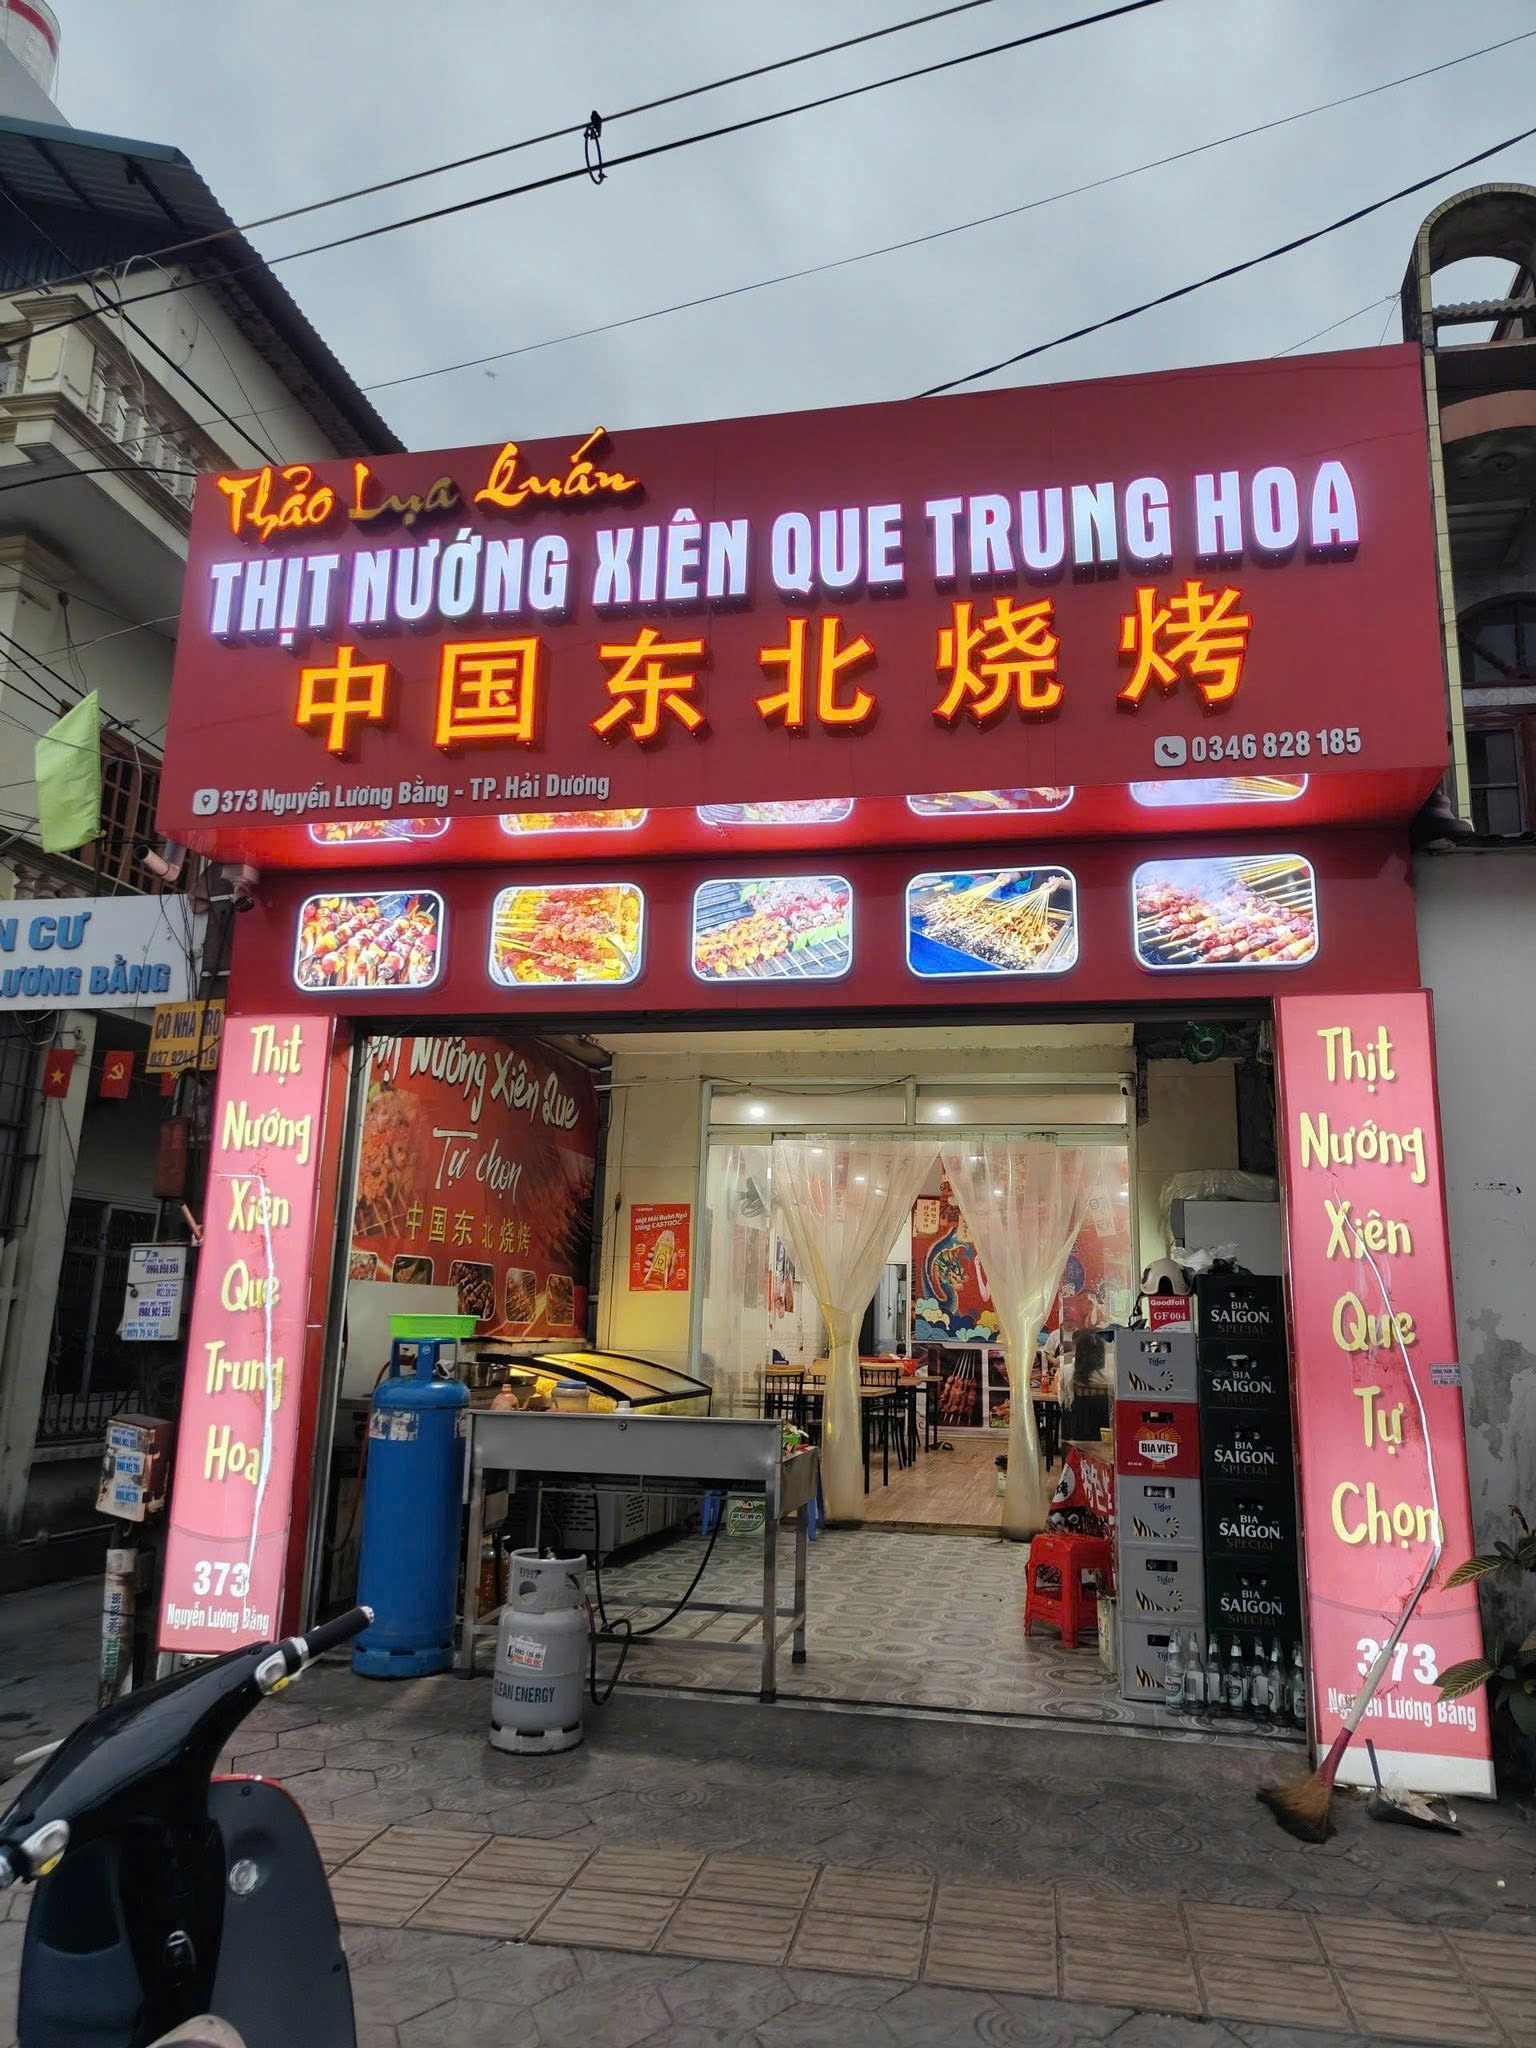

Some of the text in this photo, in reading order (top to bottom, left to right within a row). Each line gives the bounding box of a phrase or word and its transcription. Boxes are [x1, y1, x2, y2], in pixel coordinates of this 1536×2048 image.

[217, 426, 641, 543] Thảo Lụa Quán
[210, 460, 1360, 645] THỊT NƯỚNG XIÊN QUE TRUNG HOA
[295, 579, 1253, 754] 中国东北烧烤
[1191, 727, 1362, 762] 0346 828 185
[221, 789, 258, 813] 373
[261, 782, 331, 815] Nguyễn
[335, 783, 394, 810] Lương
[398, 776, 449, 808] Bằng
[470, 777, 502, 801] TP.
[504, 773, 542, 799] Hải
[546, 772, 610, 800] Dương
[28, 911, 92, 951] CƯ
[0, 954, 171, 997] ƯƠNG BẰNG
[251, 1023, 304, 1085] Thịt
[1317, 1025, 1396, 1094] Thịt
[490, 1050, 540, 1124] Xiên
[542, 1071, 580, 1129] Que
[222, 1101, 313, 1165] Nướng
[1300, 1111, 1427, 1185] Nướng
[432, 1126, 523, 1206] Tự chọn
[228, 1178, 290, 1232] Xiên
[405, 1200, 532, 1257] 中国东北烧烤
[1324, 1199, 1413, 1259] Xiên
[221, 1258, 281, 1312] Que
[1231, 1301, 1249, 1310] BIA
[1153, 1312, 1186, 1321] GF 004
[1211, 1309, 1270, 1323] SAIGON
[1332, 1290, 1417, 1350] Que
[204, 1340, 284, 1411] Trung
[1212, 1378, 1272, 1394] SAIGON
[1232, 1370, 1251, 1379] BIA
[1353, 1385, 1405, 1456] Tự
[204, 1424, 260, 1485] Hoa
[1141, 1442, 1176, 1455] BIA VIỆT
[1214, 1449, 1274, 1465] SAIGON
[1234, 1441, 1253, 1450] BIA
[1153, 1502, 1172, 1512] Tiger
[1240, 1514, 1258, 1524] BIA
[1331, 1480, 1444, 1550] Chọn
[1219, 1522, 1280, 1539] SAIGON
[193, 1560, 250, 1597] 373
[1156, 1574, 1176, 1585] Tiger
[1241, 1589, 1260, 1599] BIA
[166, 1600, 270, 1637] Nguyễn Lương Bằng
[1220, 1597, 1282, 1615] SAIGON
[1356, 1637, 1439, 1685] 373
[515, 1686, 556, 1703] ENERGY
[1387, 1693, 1432, 1728] Lương
